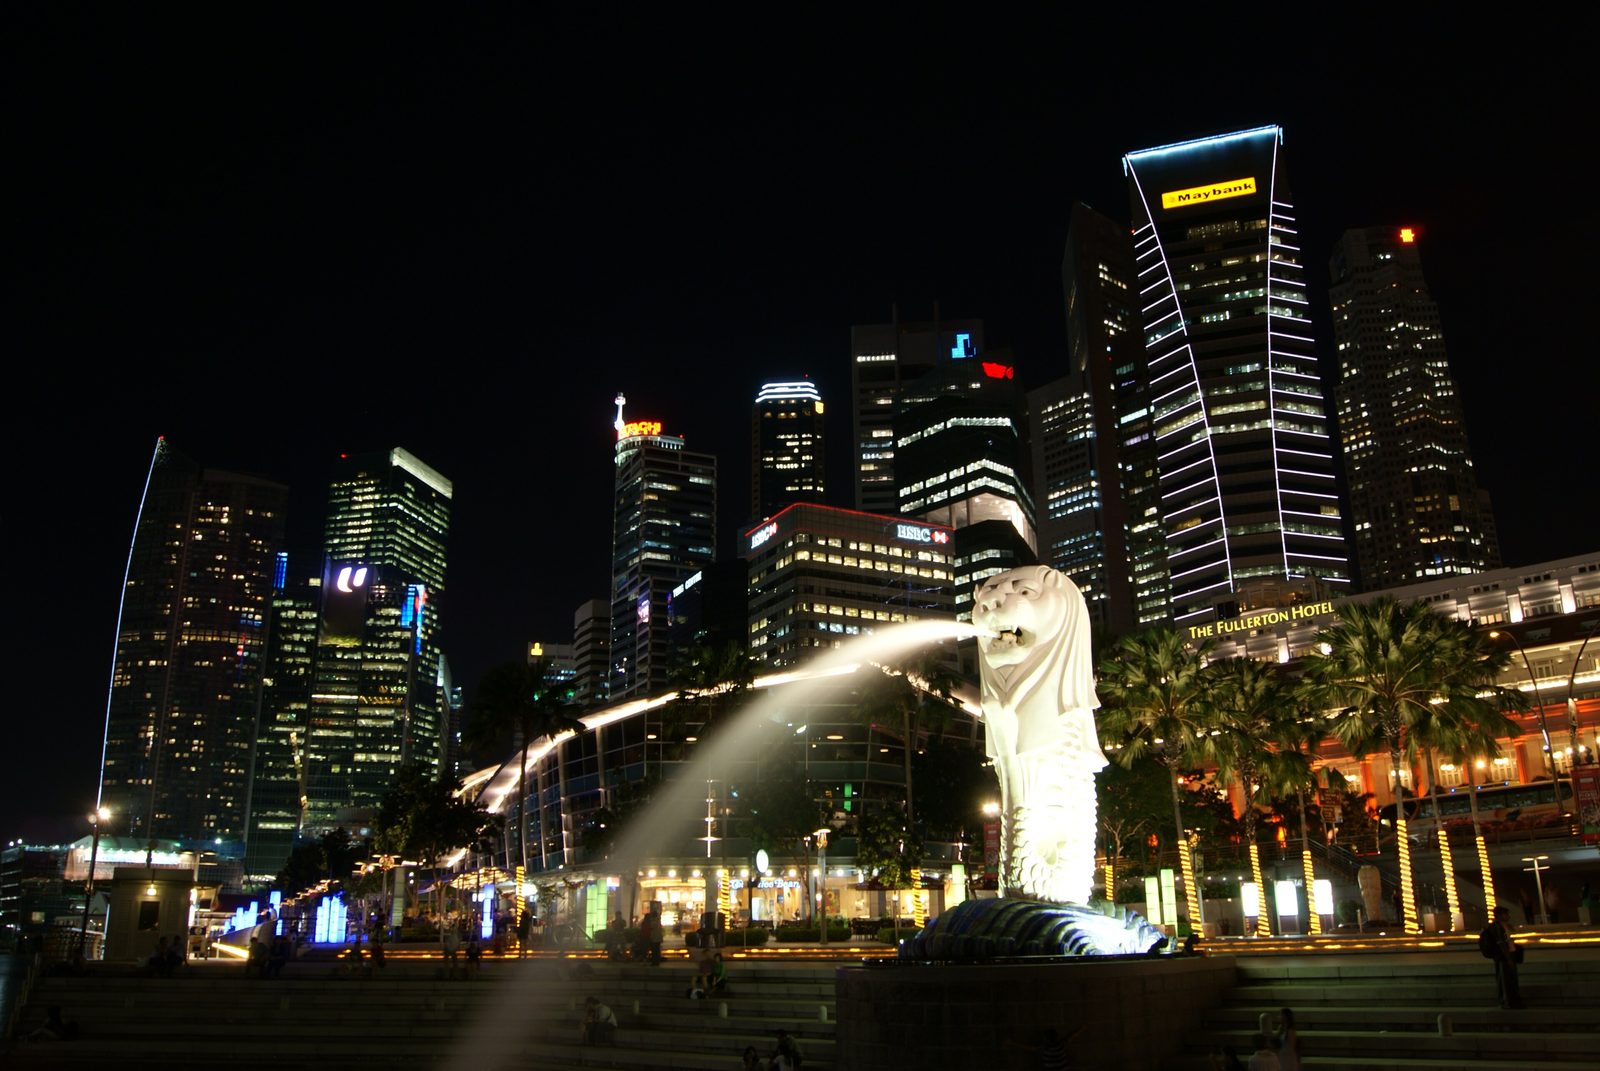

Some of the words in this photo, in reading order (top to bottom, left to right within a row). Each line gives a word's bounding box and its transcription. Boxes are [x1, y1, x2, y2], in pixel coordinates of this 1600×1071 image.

[1177, 183, 1253, 202] Maybank
[897, 524, 931, 542] HSBC
[1188, 625, 1214, 639] THE
[1216, 610, 1289, 634] FULLERTON
[1291, 602, 1335, 620] HOTEL
